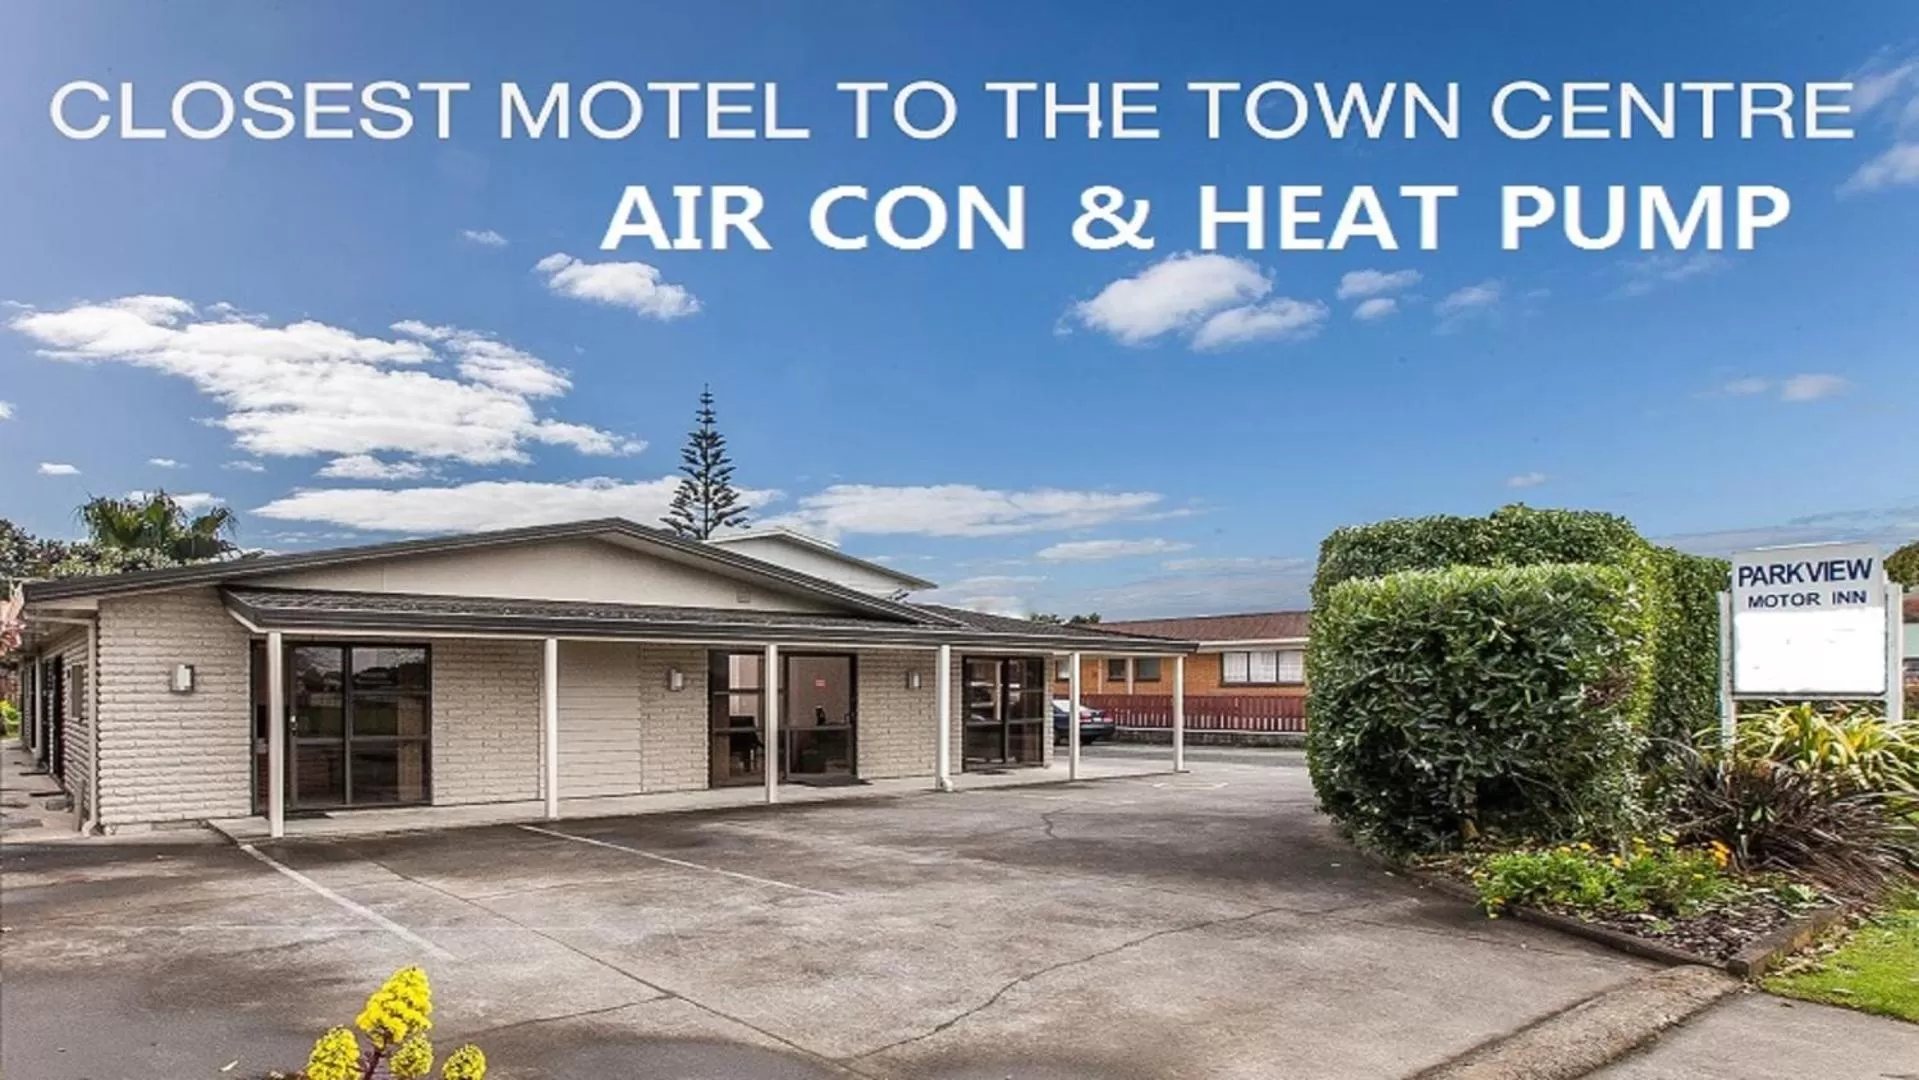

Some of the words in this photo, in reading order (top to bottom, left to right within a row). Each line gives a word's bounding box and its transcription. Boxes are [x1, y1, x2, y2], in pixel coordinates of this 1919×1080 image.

[1738, 558, 1873, 587] PARKVIEW
[1748, 592, 1821, 608] MOTOR
[1832, 590, 1867, 605] INN
